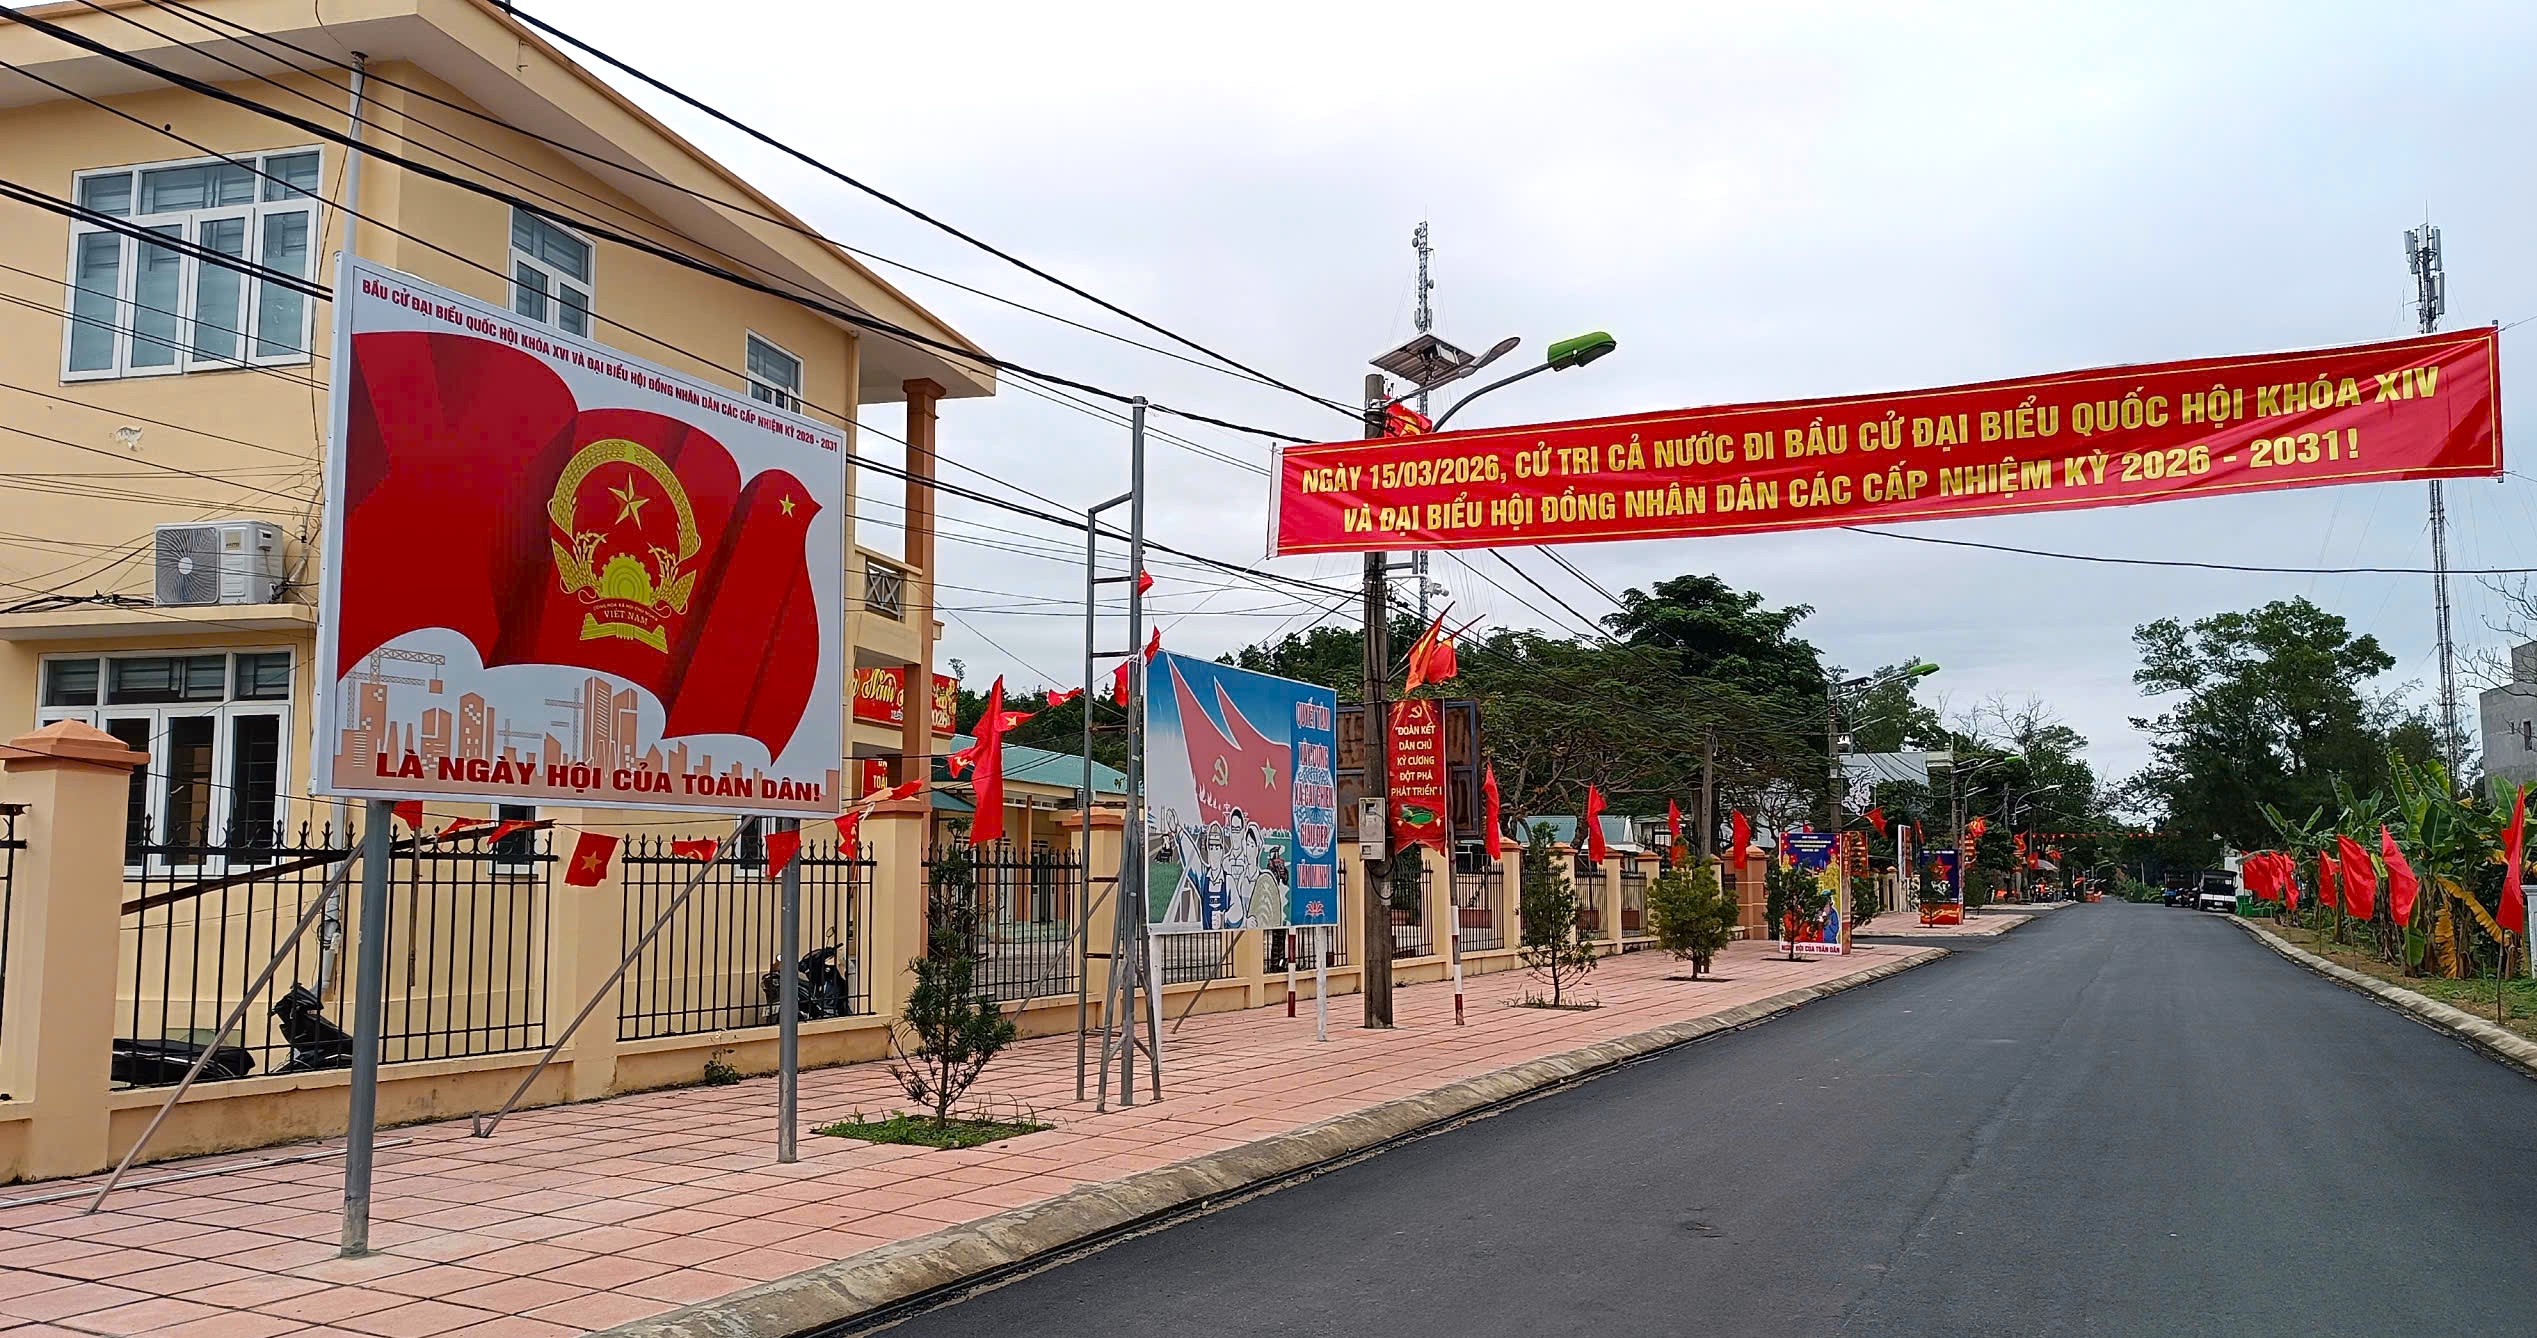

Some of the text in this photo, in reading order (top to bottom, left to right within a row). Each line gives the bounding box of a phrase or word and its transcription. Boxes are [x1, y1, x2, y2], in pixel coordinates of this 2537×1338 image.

[362, 279, 388, 300] BẦU
[391, 287, 411, 305] CỬ
[412, 297, 432, 316] ĐẠI
[436, 305, 463, 325] BIỂU
[466, 316, 497, 337] QUỐC
[499, 327, 518, 345] HỘI
[521, 335, 550, 355] KHÓA
[553, 344, 569, 362] XVI
[572, 352, 585, 367] VÀ
[587, 356, 604, 375] ĐẠI
[606, 364, 628, 382] BIỂU
[631, 372, 647, 388] HỘI
[648, 377, 674, 396] ĐỒNG
[675, 386, 700, 407] NHÂN
[702, 394, 720, 413] DÂN
[721, 403, 738, 419] CÁC
[740, 408, 756, 425] CẤP
[758, 415, 784, 435] NHIỆM
[784, 423, 795, 439] KỲ
[796, 429, 814, 445] 2026
[821, 438, 838, 453] 2031
[1302, 366, 2440, 494] NGÀY 15/03/2026, CỬ TRI CẢ NƯỚC ĐI BẦU CỬ ĐẠI BIỂU QUỐC HỘI KHÓA XIV
[1344, 503, 1373, 534] VÀ
[1378, 504, 1420, 537] ĐẠI
[1426, 491, 1482, 530] BIỂU
[1491, 492, 1533, 531] HỘI
[1541, 485, 1616, 523] ĐỒNG
[1625, 481, 1706, 519] NHÂN
[1716, 476, 1779, 513] DÂN
[1788, 471, 1852, 508] CÁC
[1862, 459, 1928, 503] CẤP
[1939, 455, 2052, 499] NHIỆM
[2063, 448, 2110, 488] KỲ
[2120, 445, 2211, 482] 2026
[2249, 428, 2360, 469] 2031!
[628, 611, 648, 625] NAM
[1420, 722, 1436, 735] KẾT
[1399, 738, 1432, 751] DÂN CHỦ
[1408, 755, 1435, 766] CƯƠNG
[375, 748, 821, 803] LÀ NGÀY HỘI CỦA TOÀN DÂN!
[1400, 769, 1433, 783] ĐỘT PHÁ
[1391, 785, 1413, 797] PHÁT
